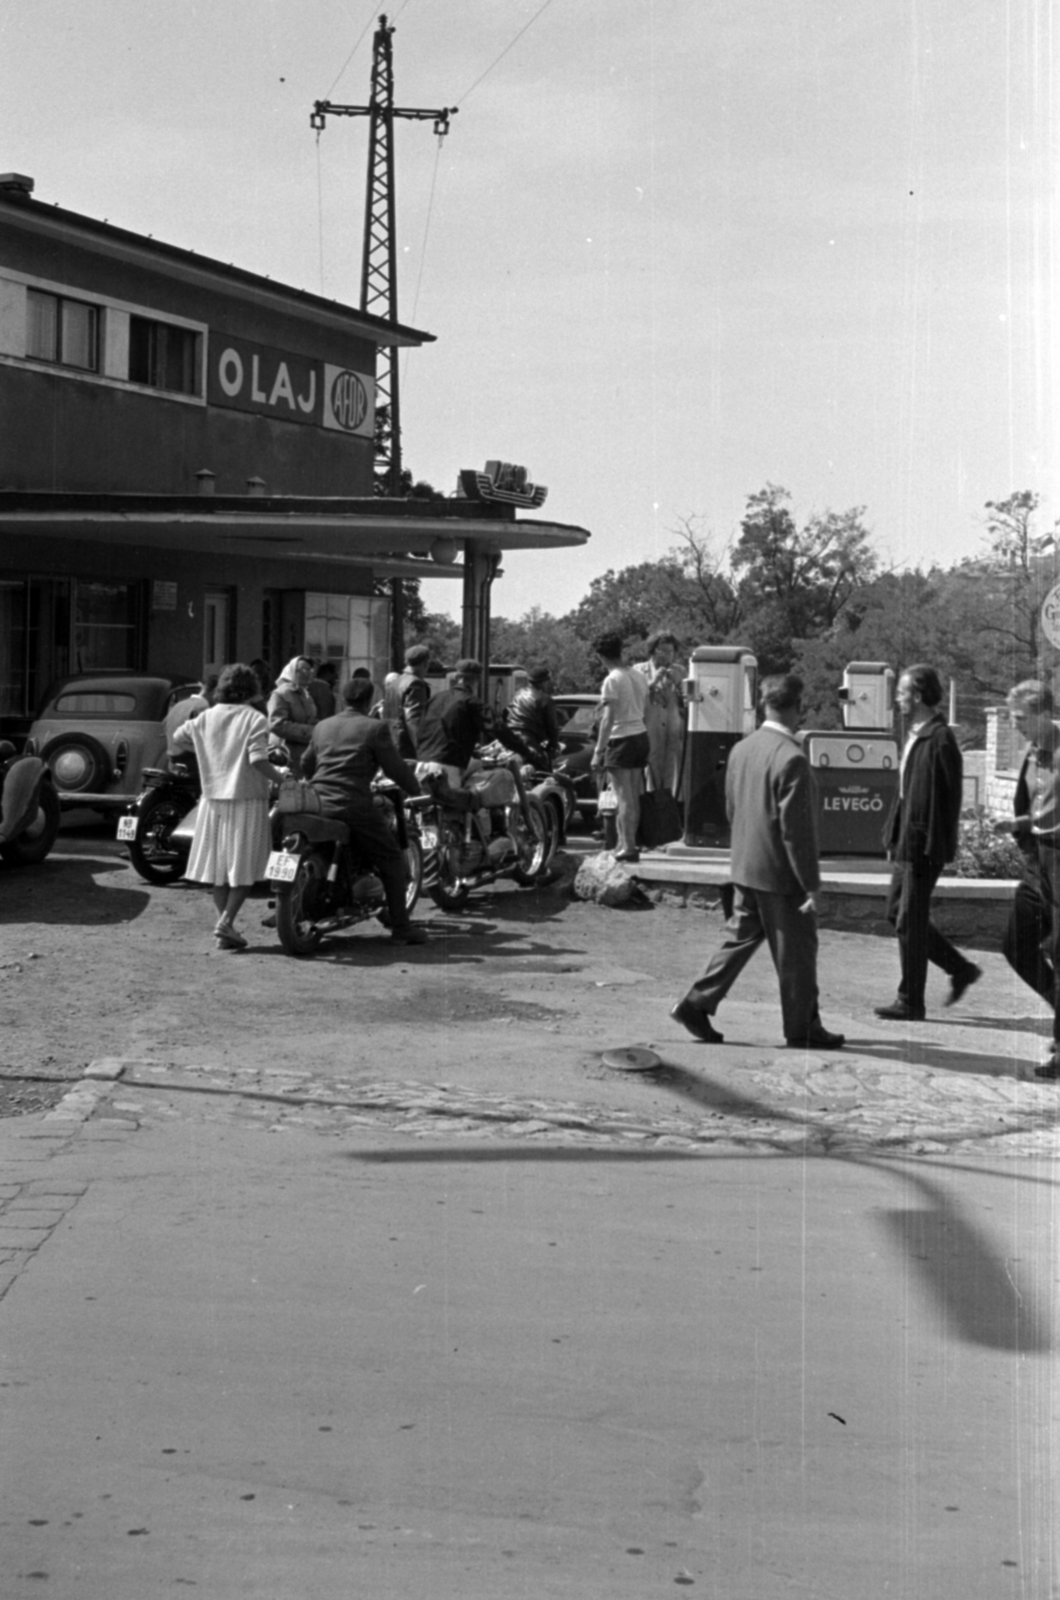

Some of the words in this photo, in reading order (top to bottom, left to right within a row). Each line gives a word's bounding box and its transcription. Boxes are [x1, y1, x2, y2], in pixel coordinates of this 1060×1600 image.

[219, 348, 316, 413] OLAJ
[333, 373, 365, 427] AFOR
[824, 793, 883, 811] LEVEGŐ
[268, 865, 295, 879] 1990
